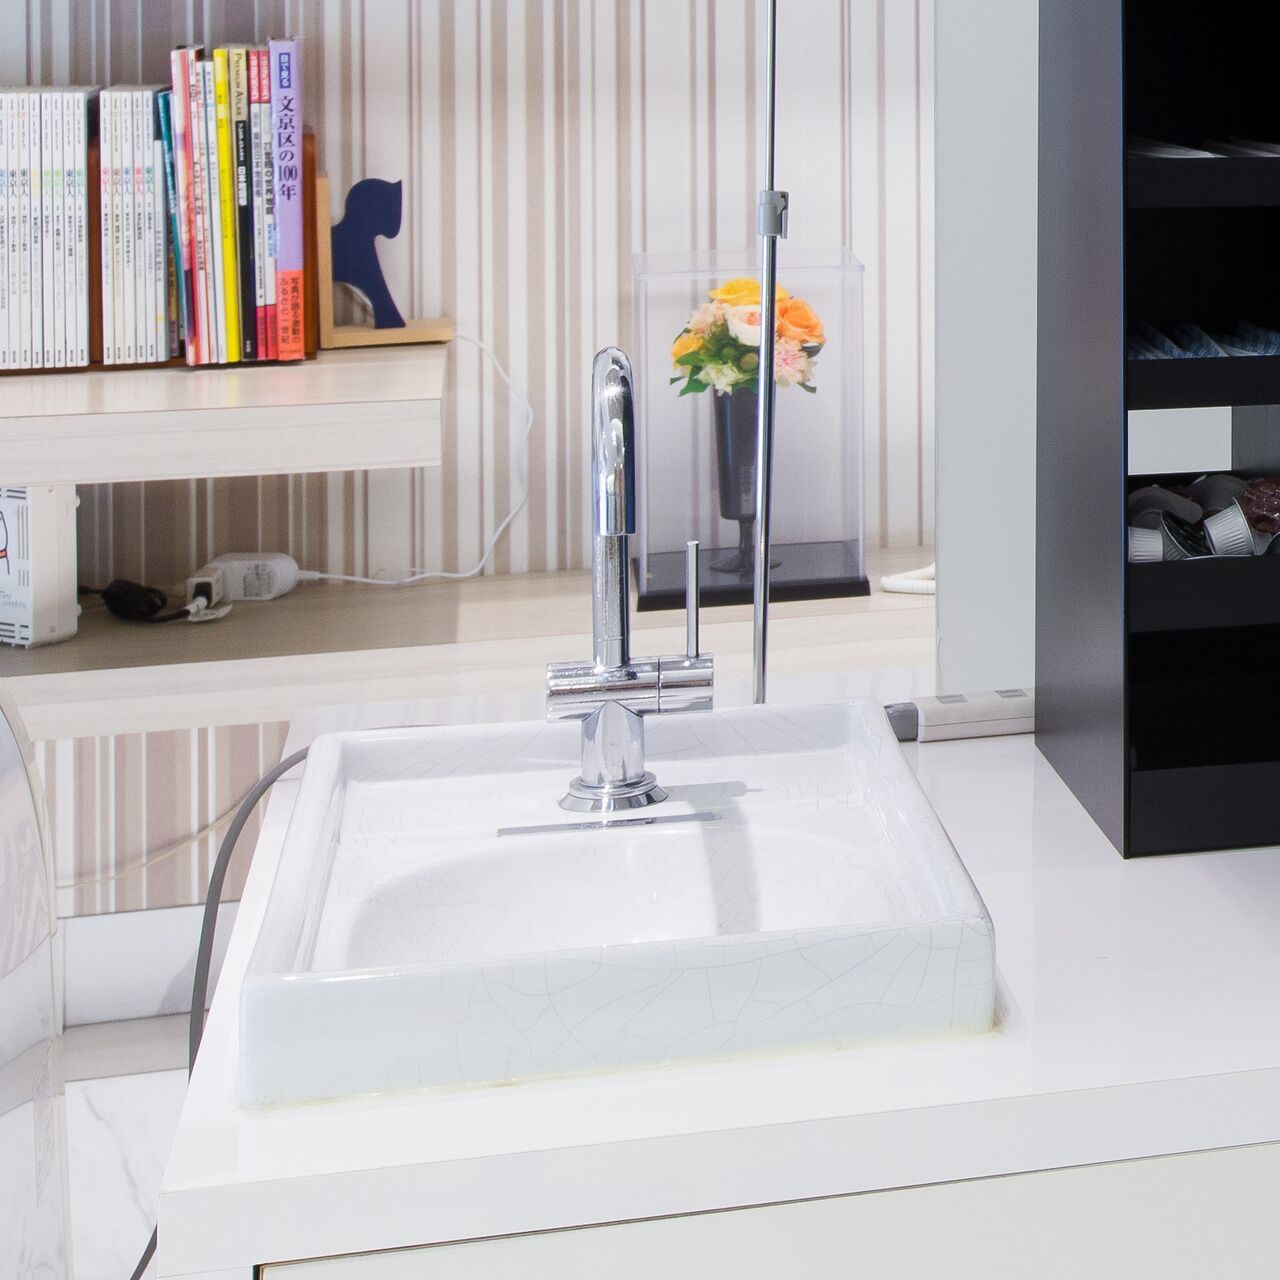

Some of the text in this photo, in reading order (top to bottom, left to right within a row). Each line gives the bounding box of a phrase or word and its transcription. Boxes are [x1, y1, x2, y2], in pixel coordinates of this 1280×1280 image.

[278, 95, 298, 201] 文京区の100年
